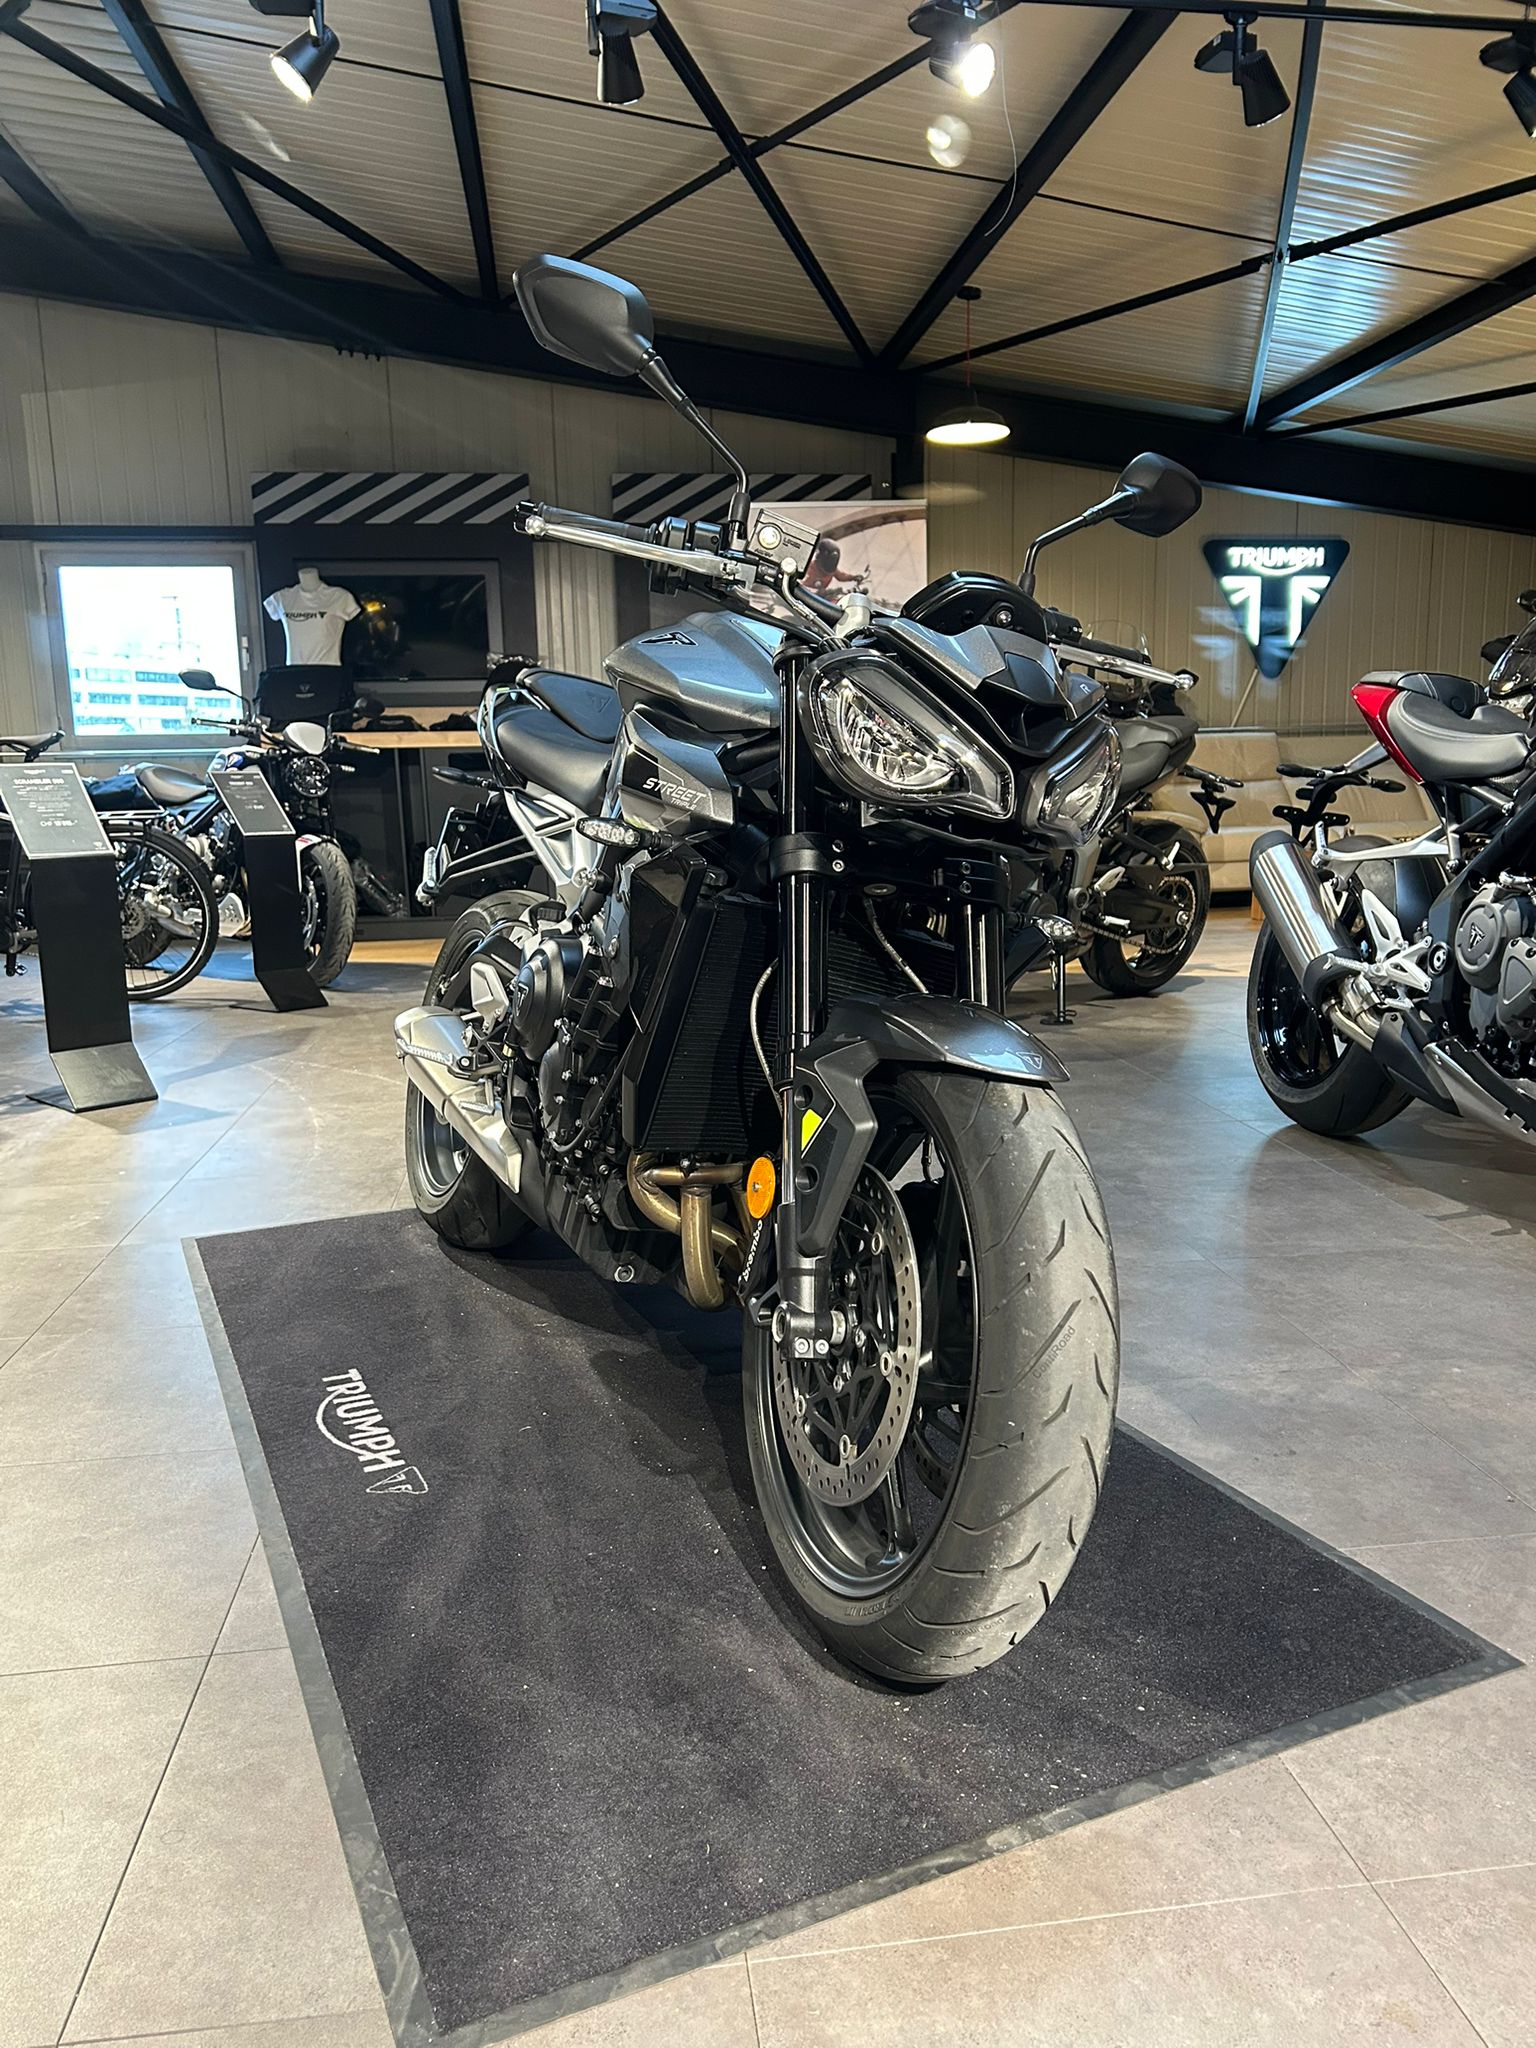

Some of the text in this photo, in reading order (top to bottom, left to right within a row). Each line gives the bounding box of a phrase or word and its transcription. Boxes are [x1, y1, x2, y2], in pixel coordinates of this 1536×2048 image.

[1227, 546, 1325, 575] TRIUMPH
[642, 777, 707, 804] STREET
[671, 797, 697, 811] TRIPLE
[1032, 1325, 1076, 1379] ContiRoad
[315, 1368, 406, 1473] TRIUMPH
